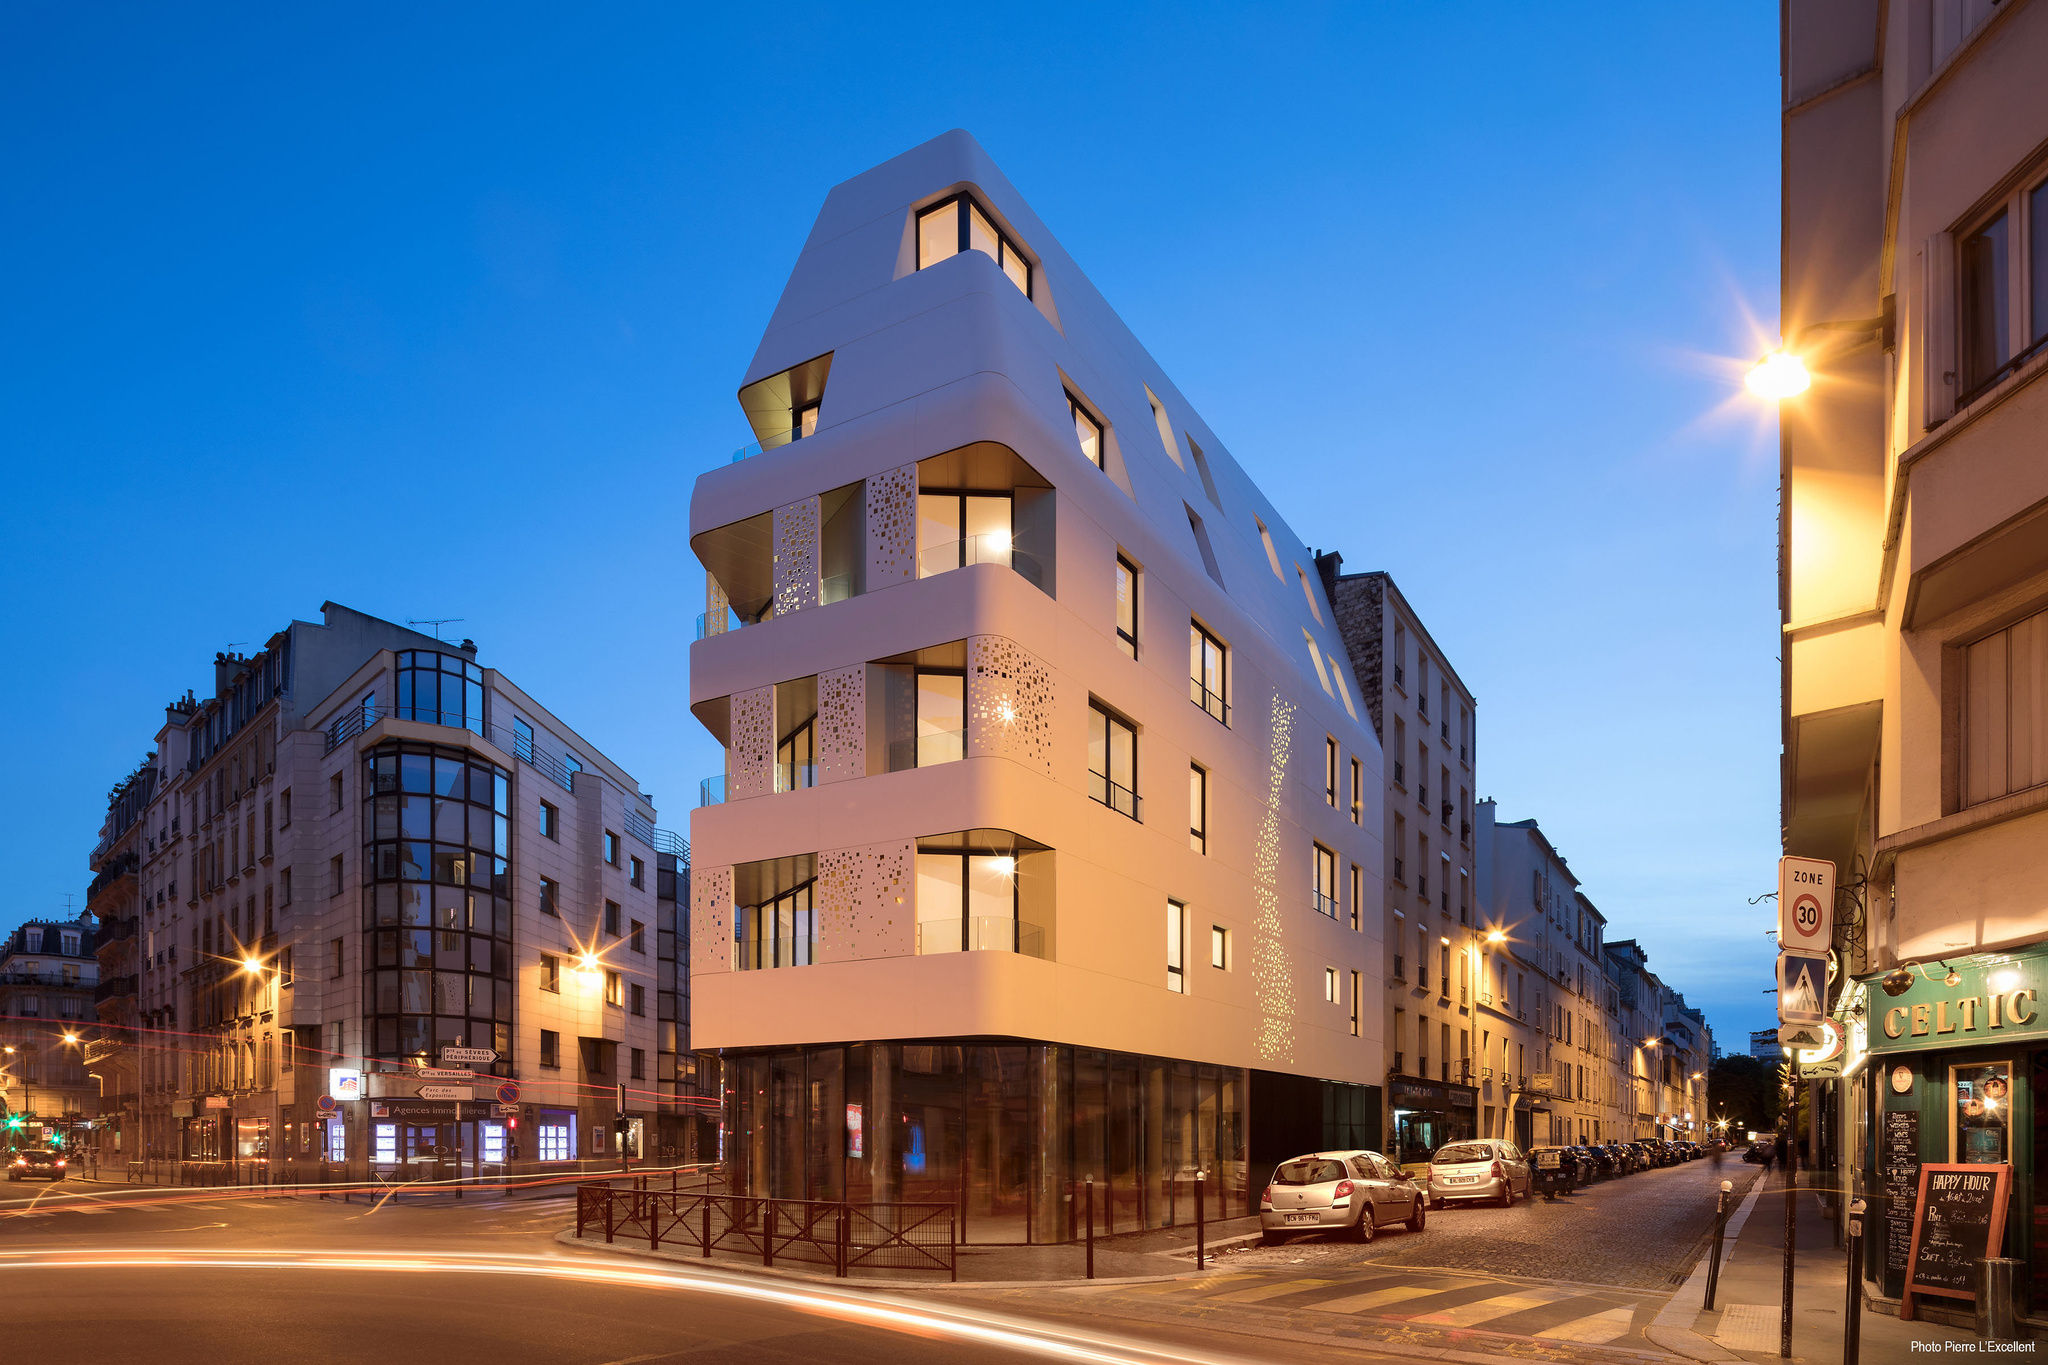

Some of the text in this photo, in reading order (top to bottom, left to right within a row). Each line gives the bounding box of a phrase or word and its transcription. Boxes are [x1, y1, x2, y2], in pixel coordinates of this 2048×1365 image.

[1794, 870, 1823, 885] ZONE
[1798, 905, 1816, 925] 30
[1883, 989, 2038, 1039] CELTIC
[393, 1105, 487, 1115] Agences Immoilières
[1932, 1174, 1991, 1190] HAPPY HOUR
